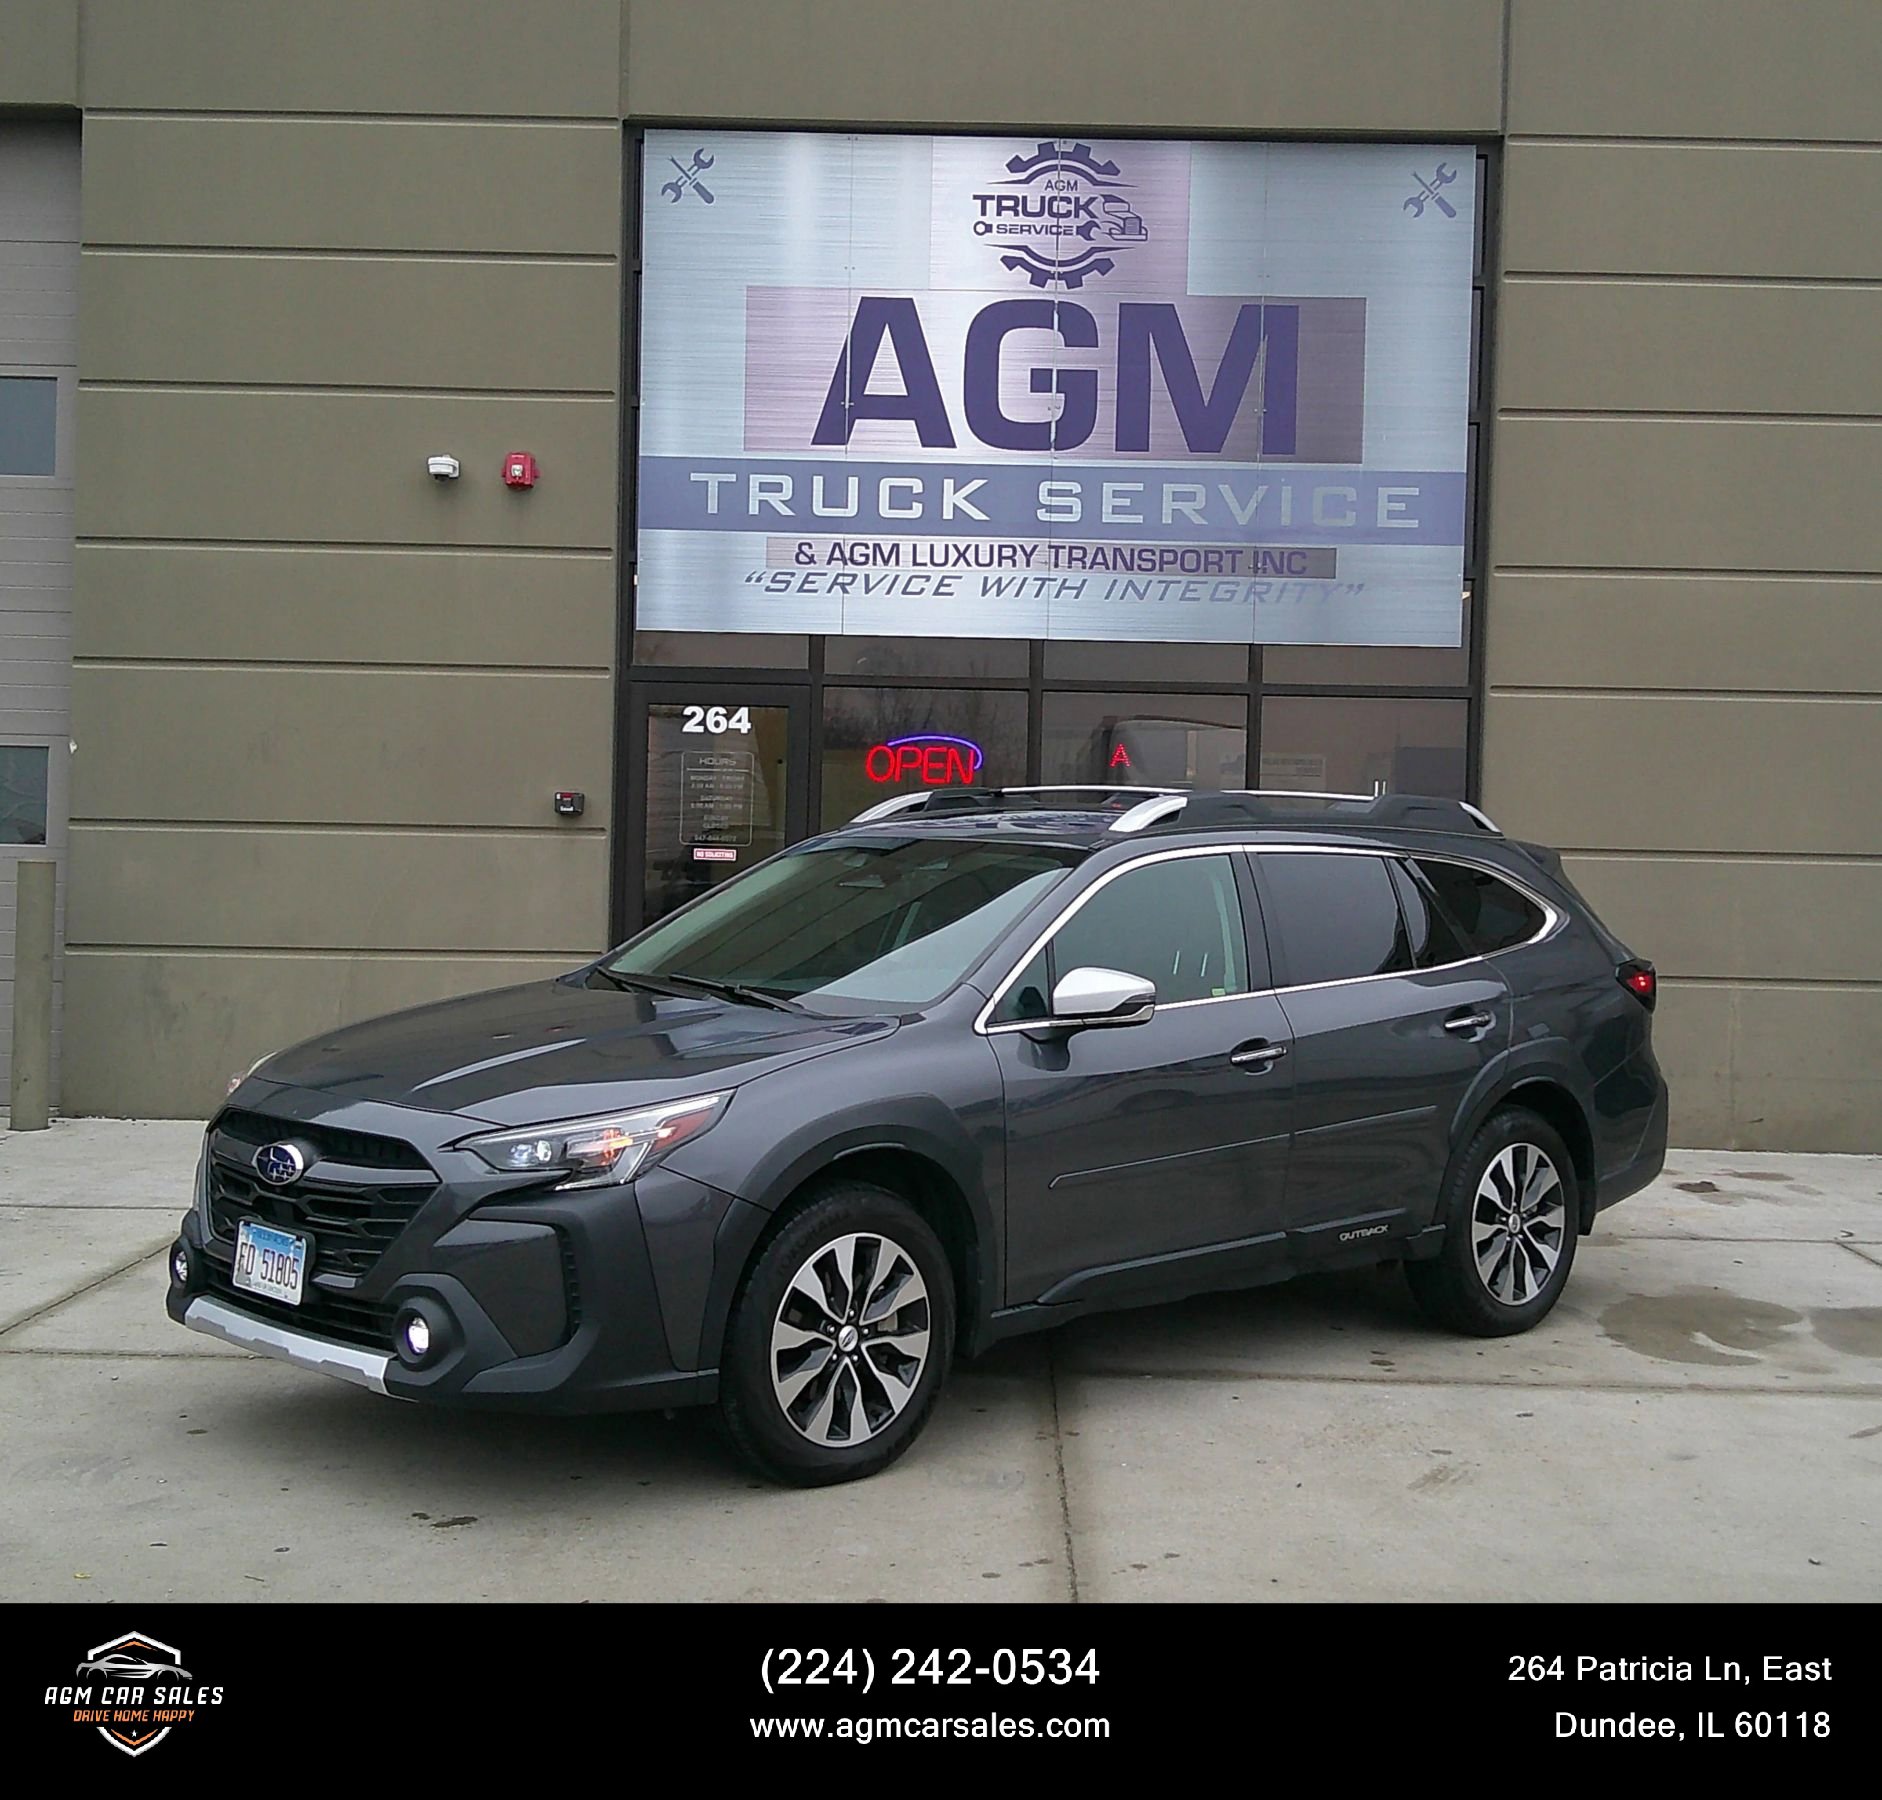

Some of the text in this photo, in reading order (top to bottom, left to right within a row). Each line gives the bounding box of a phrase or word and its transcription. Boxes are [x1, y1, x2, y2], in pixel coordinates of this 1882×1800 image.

[1044, 179, 1079, 192] AGM
[972, 194, 1099, 219] TRUCK
[996, 223, 1074, 236] SERVICE
[811, 296, 1300, 456] AGM
[690, 473, 1420, 529] TRUCK SERVICE
[795, 542, 1308, 575] & AGM LUXURY TRANSPORT INC
[979, 576, 1088, 600] WITH
[682, 706, 752, 734] 264
[865, 745, 975, 785] OPEN
[1109, 743, 1132, 768] A
[1339, 1224, 1389, 1241] OUTBACK
[261, 1248, 300, 1290] 51805
